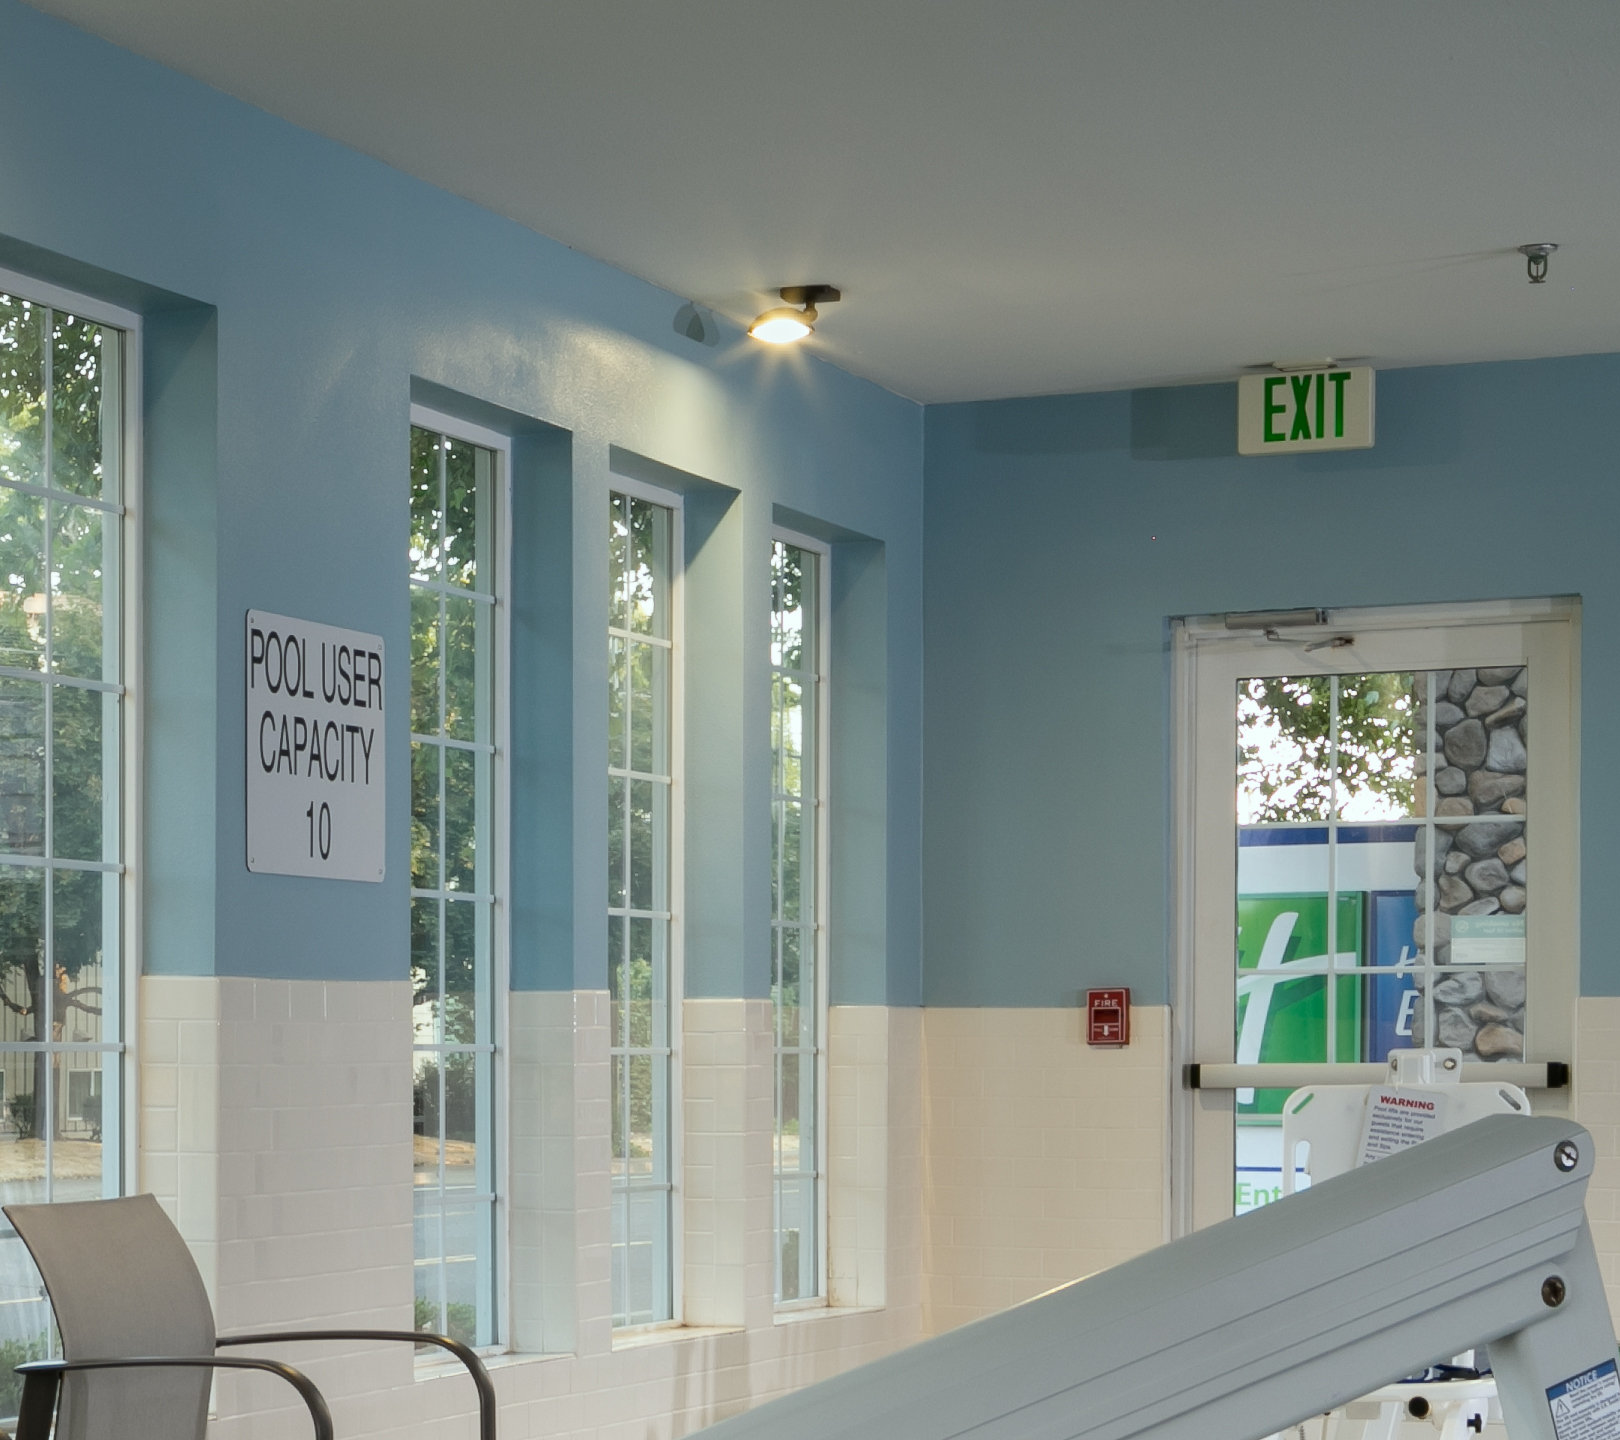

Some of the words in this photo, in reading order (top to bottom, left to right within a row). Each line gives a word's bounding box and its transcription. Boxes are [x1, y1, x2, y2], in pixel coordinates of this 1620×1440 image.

[1264, 371, 1351, 443] EXIT
[250, 628, 315, 699] POOL
[321, 641, 382, 710] USER
[260, 710, 374, 784] CAPACITY
[306, 800, 331, 860] 10
[1380, 1095, 1435, 1111] WARNING
[1565, 1370, 1598, 1392] NOTICE
